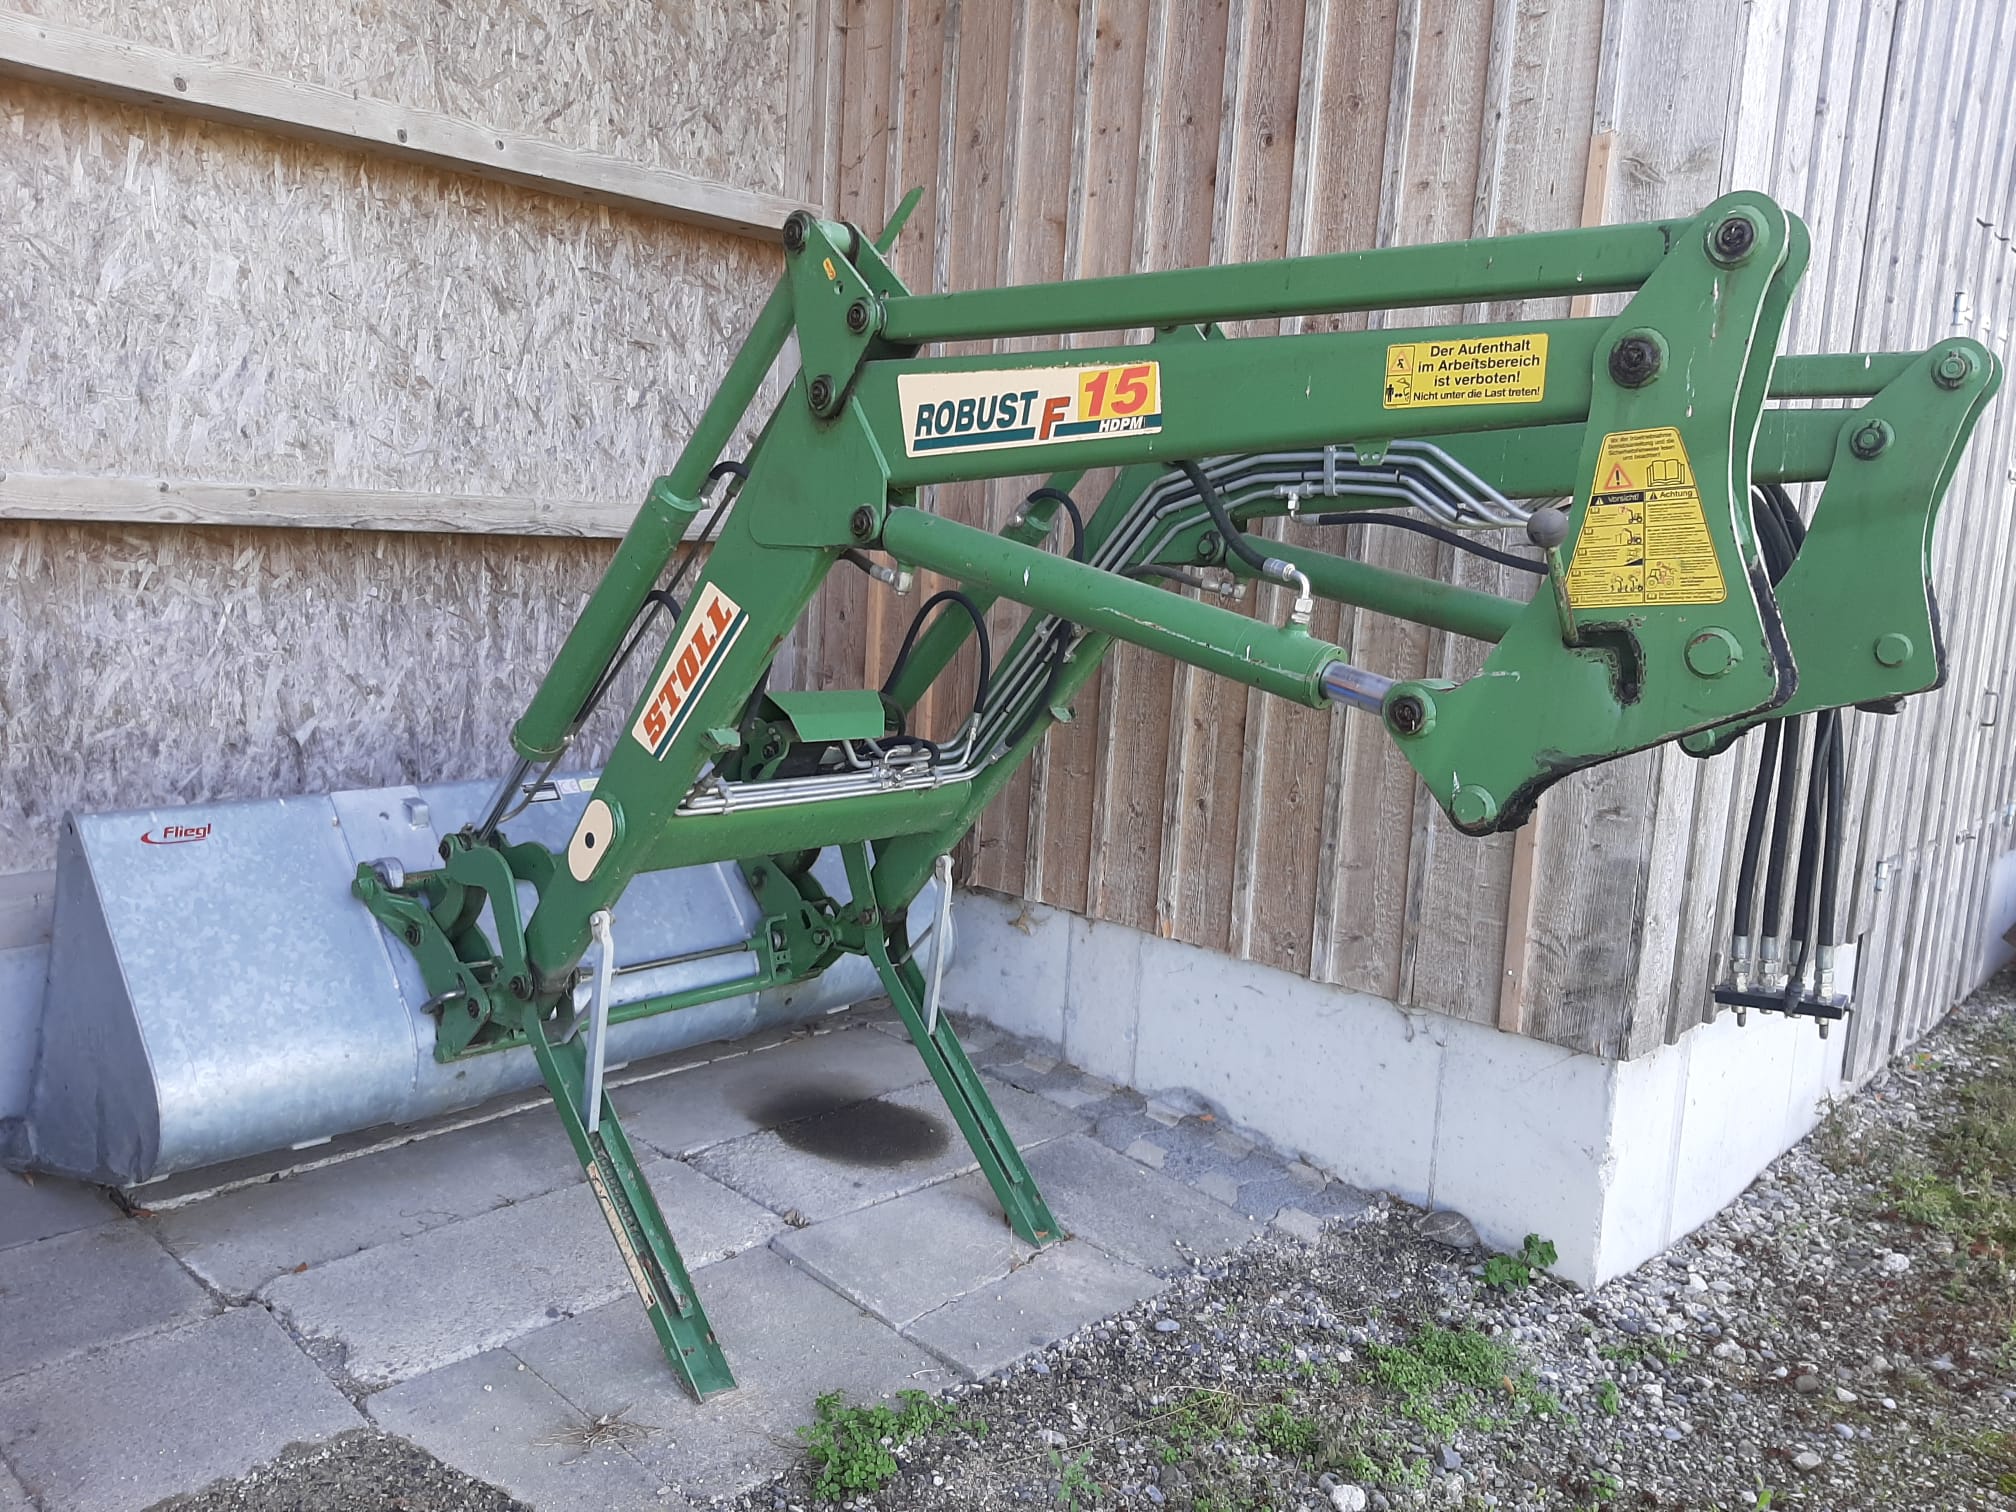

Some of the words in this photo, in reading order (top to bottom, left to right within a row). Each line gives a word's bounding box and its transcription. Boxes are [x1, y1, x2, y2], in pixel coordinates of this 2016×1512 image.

[1430, 345, 1454, 357] Der
[1458, 339, 1531, 356] Aufenthalt
[1418, 361, 1434, 373] im
[1438, 354, 1540, 372] Arbeitsbereich
[1434, 375, 1450, 387] ist
[1454, 371, 1521, 386] verboten!
[1413, 391, 1438, 401] Nicht
[1440, 390, 1465, 400] unter
[1467, 389, 1482, 399] die
[1484, 388, 1506, 398] Last
[1508, 386, 1540, 397] treten!
[914, 389, 1039, 437] ROBUST
[1039, 396, 1071, 441] F
[1084, 365, 1151, 418] 15
[1099, 417, 1145, 433] HDPM
[1660, 490, 1693, 499] Achtung
[643, 596, 733, 748] STOLL
[163, 823, 212, 839] Fliegl
